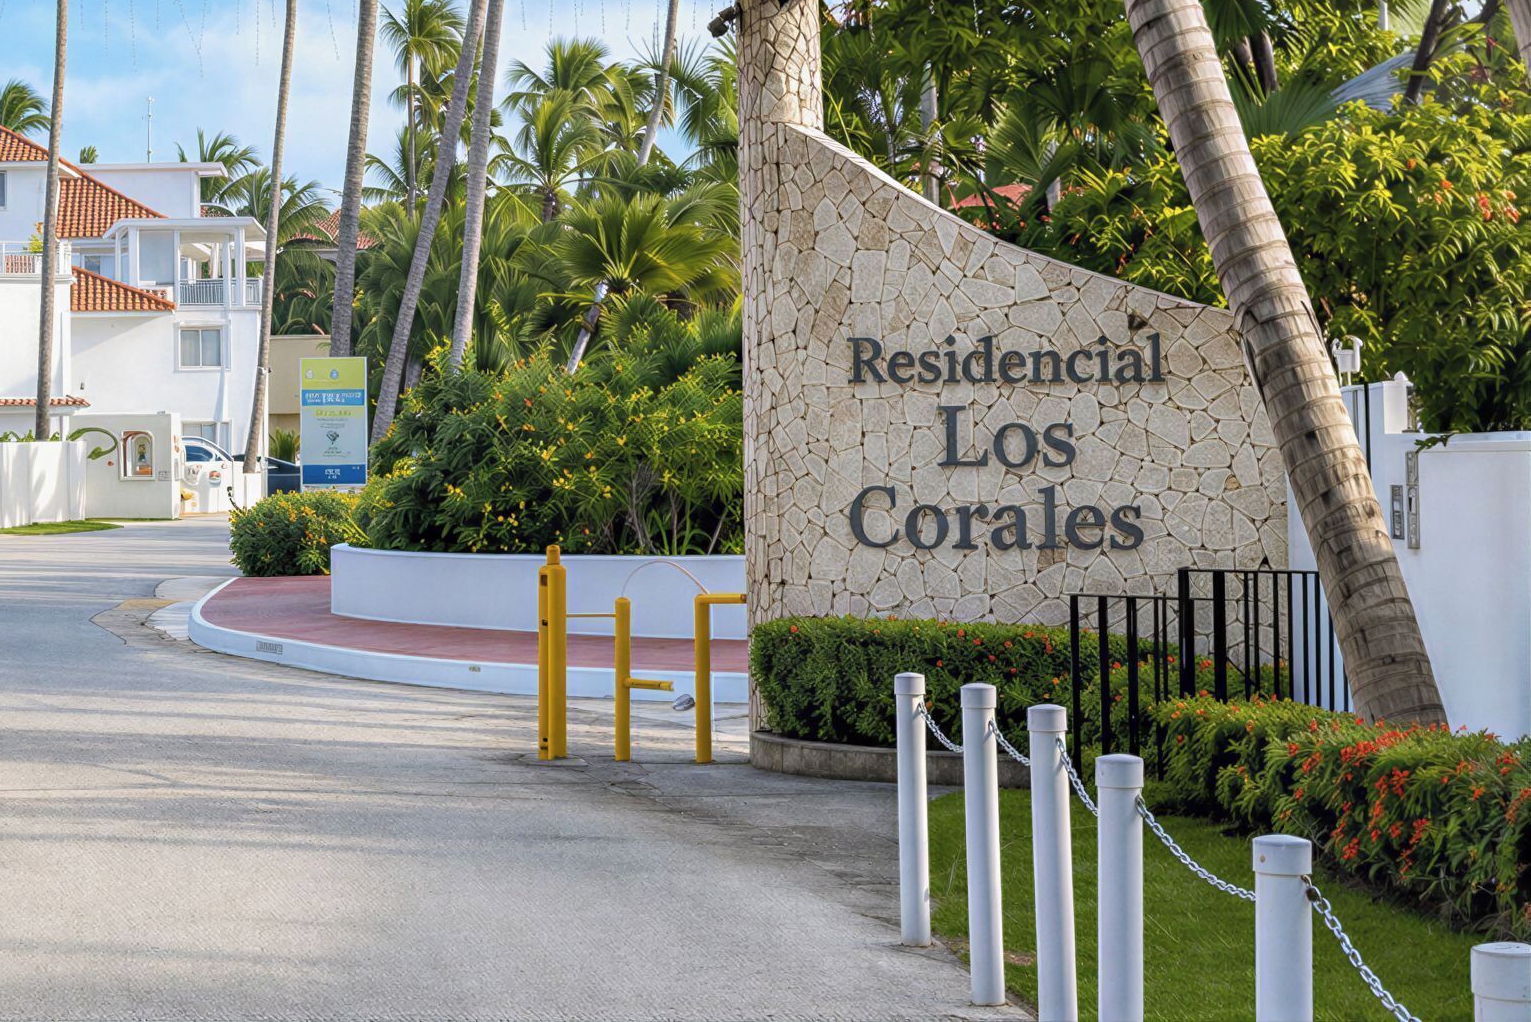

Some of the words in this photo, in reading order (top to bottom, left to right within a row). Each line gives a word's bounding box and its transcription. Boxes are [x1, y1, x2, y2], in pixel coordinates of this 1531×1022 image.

[846, 332, 1166, 385] Residencial
[937, 405, 1076, 468] Los
[849, 484, 1145, 551] Corales
